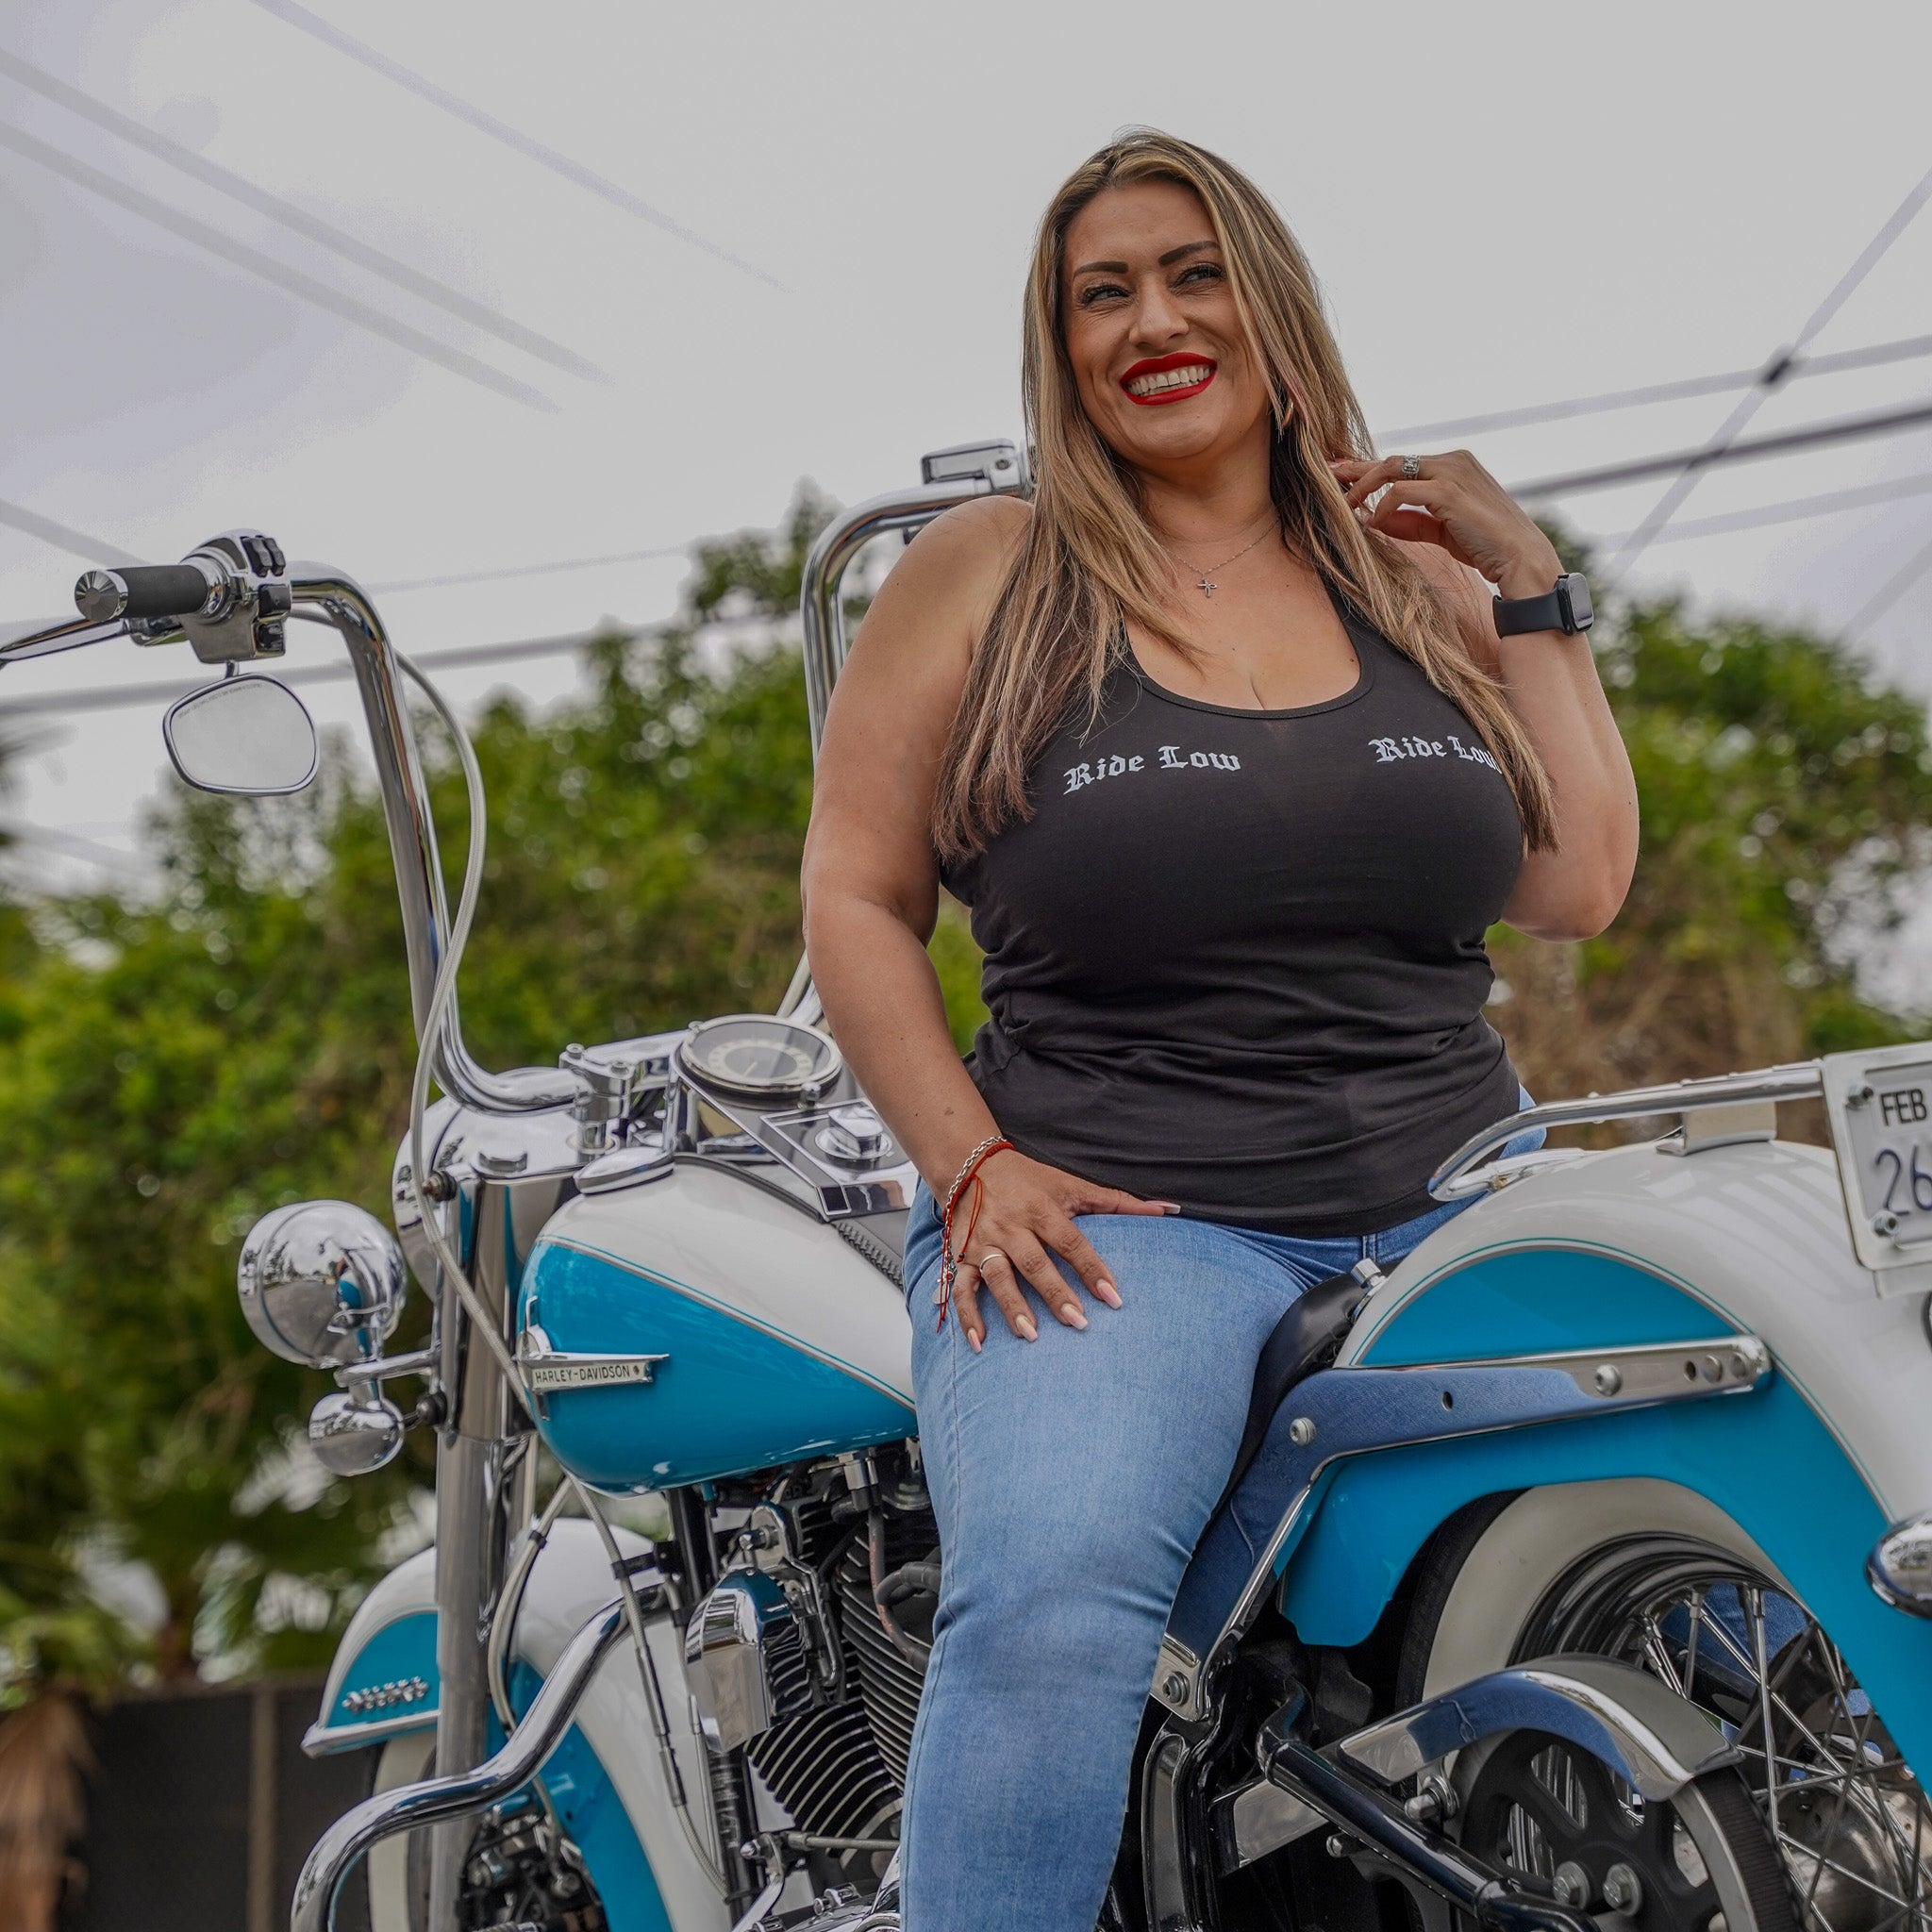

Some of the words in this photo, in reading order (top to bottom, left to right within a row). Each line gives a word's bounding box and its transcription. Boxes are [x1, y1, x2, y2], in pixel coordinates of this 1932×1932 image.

[1368, 736, 1447, 763] Ride
[1063, 755, 1144, 795] Ride
[1158, 745, 1241, 772] Low
[1880, 1089, 1927, 1126] FEB
[1874, 1144, 1932, 1216] 26
[536, 1365, 630, 1383] HARLEY-DAVIDSON
